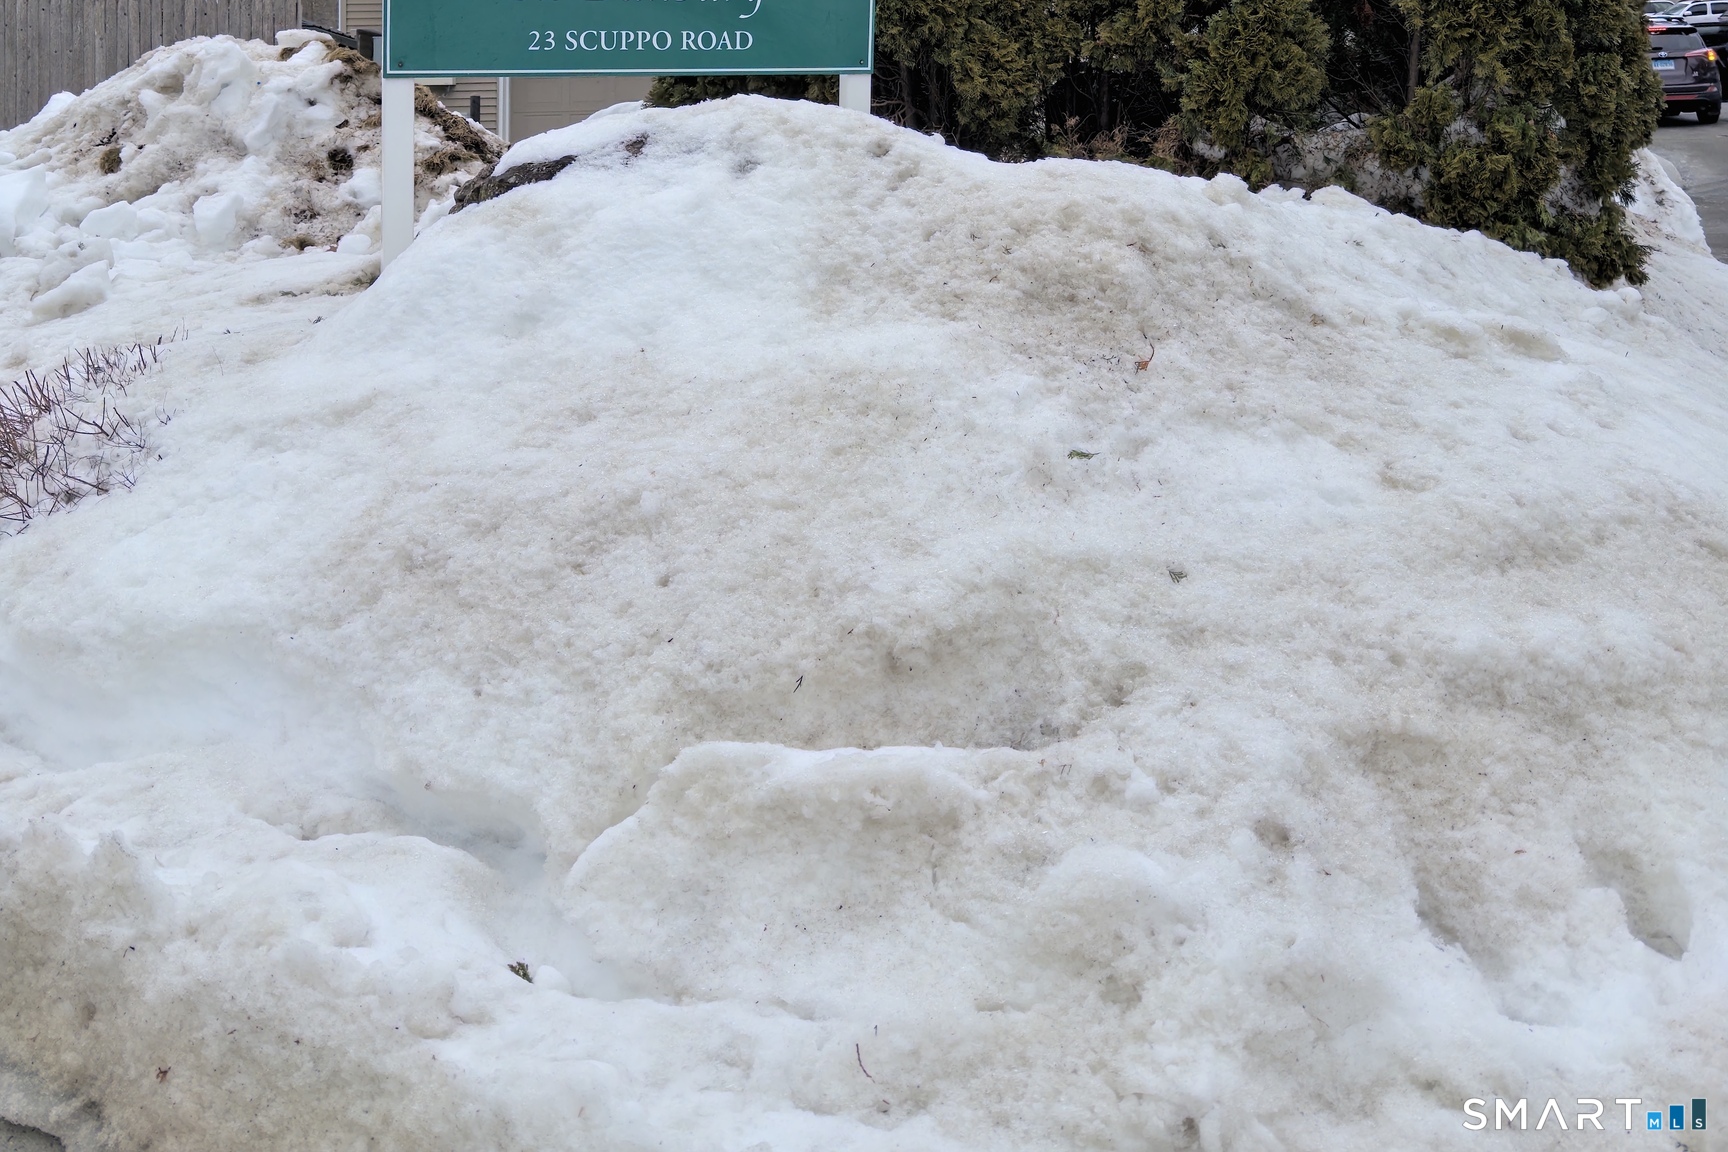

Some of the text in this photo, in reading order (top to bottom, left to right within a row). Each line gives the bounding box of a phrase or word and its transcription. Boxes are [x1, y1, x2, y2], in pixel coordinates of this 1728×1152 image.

[528, 30, 753, 51] 23 SCUPPO ROAD
